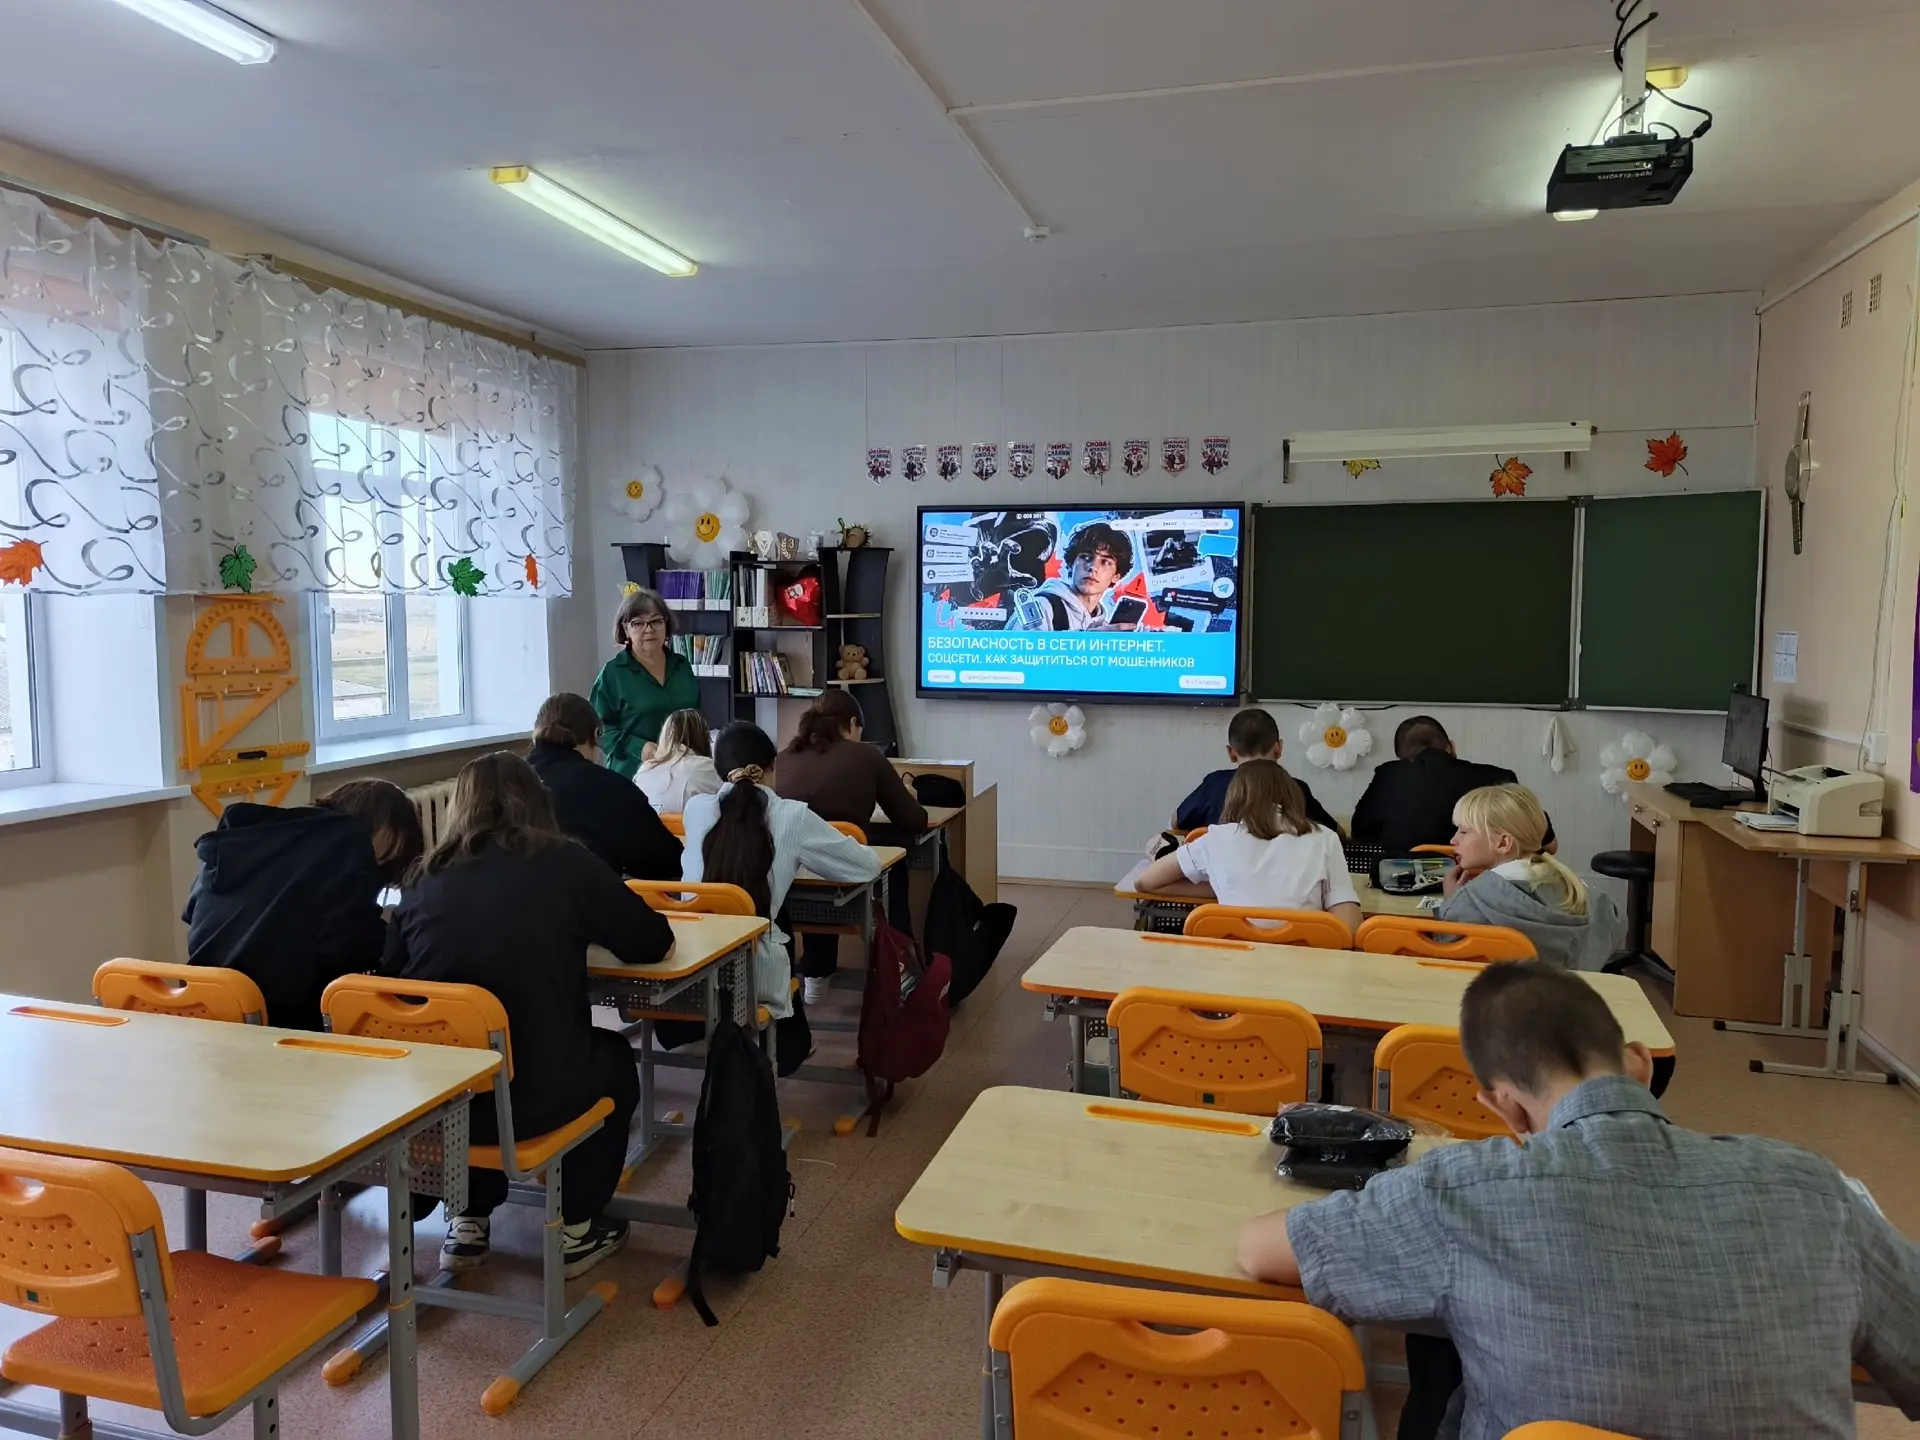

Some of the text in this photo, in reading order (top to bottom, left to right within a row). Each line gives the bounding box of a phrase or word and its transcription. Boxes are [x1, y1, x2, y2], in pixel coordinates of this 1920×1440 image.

[789, 538, 795, 548] 3
[928, 637, 1166, 653] БЕЗОПАСНОСТЬ В СЕТИ ИНТЕРНЕТ.
[928, 653, 1195, 668] СОЦСЕТИ. КАК ЗАЩИТИТЬСЯ ОТ МОШЕННИКОВ
